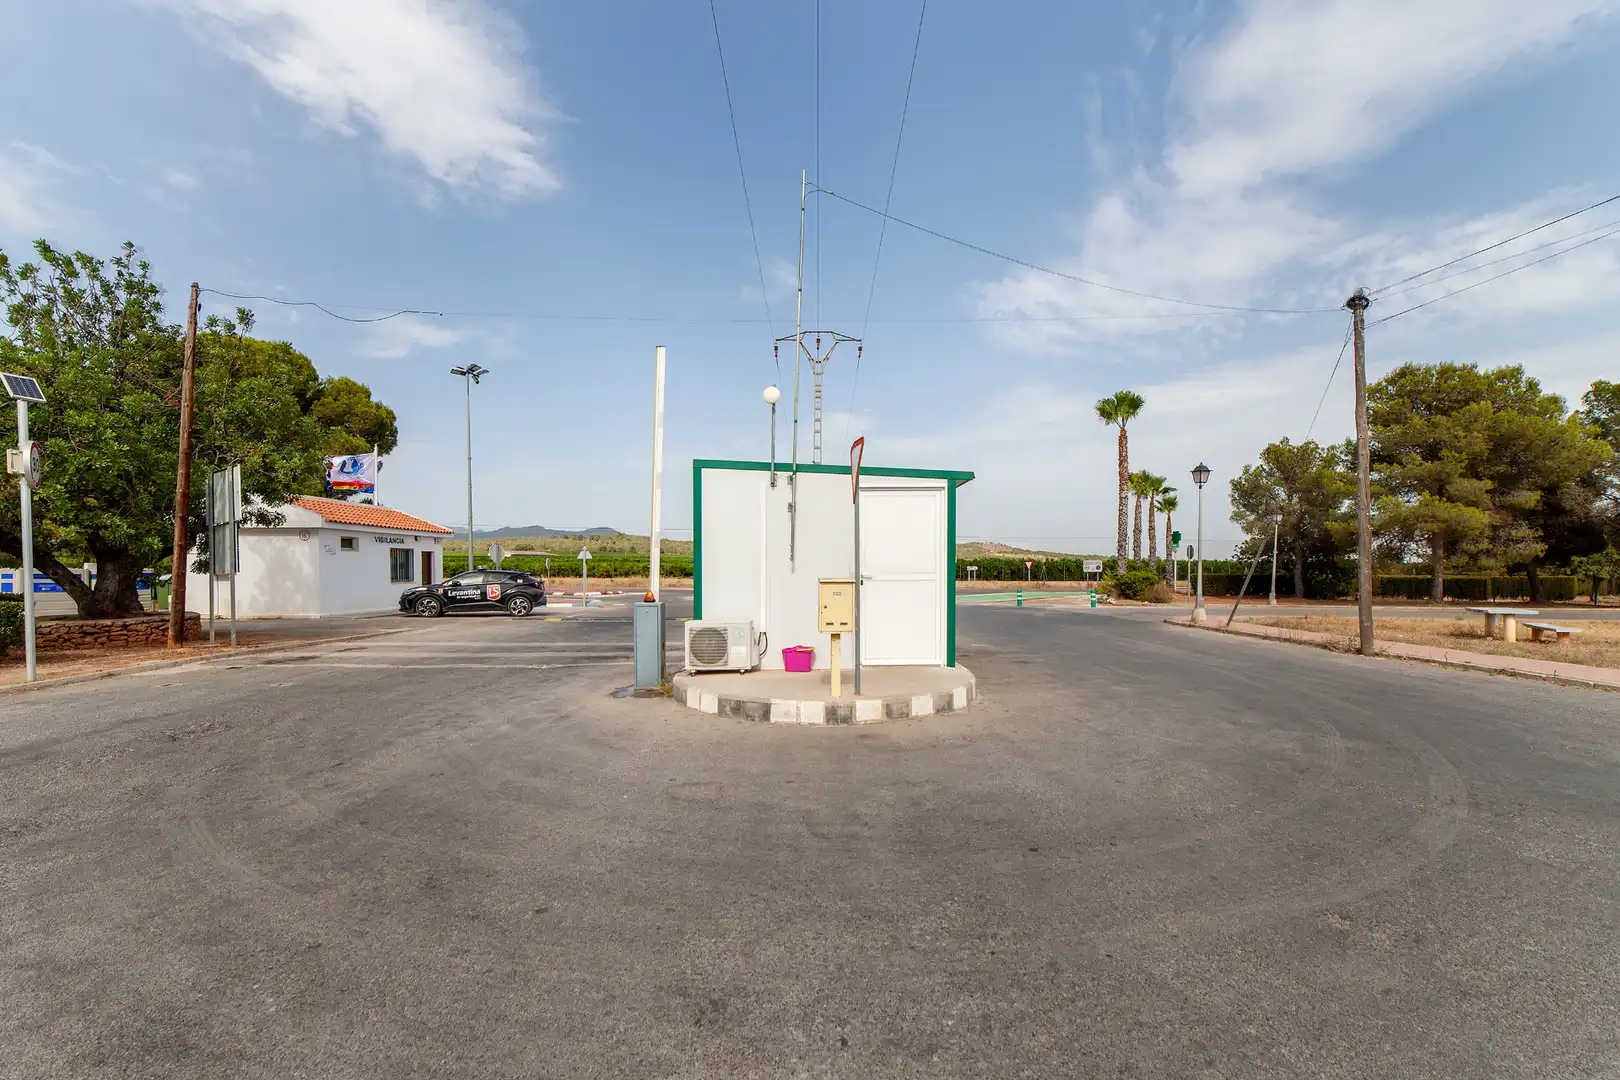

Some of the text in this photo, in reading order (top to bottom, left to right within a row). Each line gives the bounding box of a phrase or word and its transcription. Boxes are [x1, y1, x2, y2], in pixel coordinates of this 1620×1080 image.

[374, 536, 405, 545] VIGILANCIA
[448, 589, 481, 597] Levantina
[488, 587, 500, 597] LS
